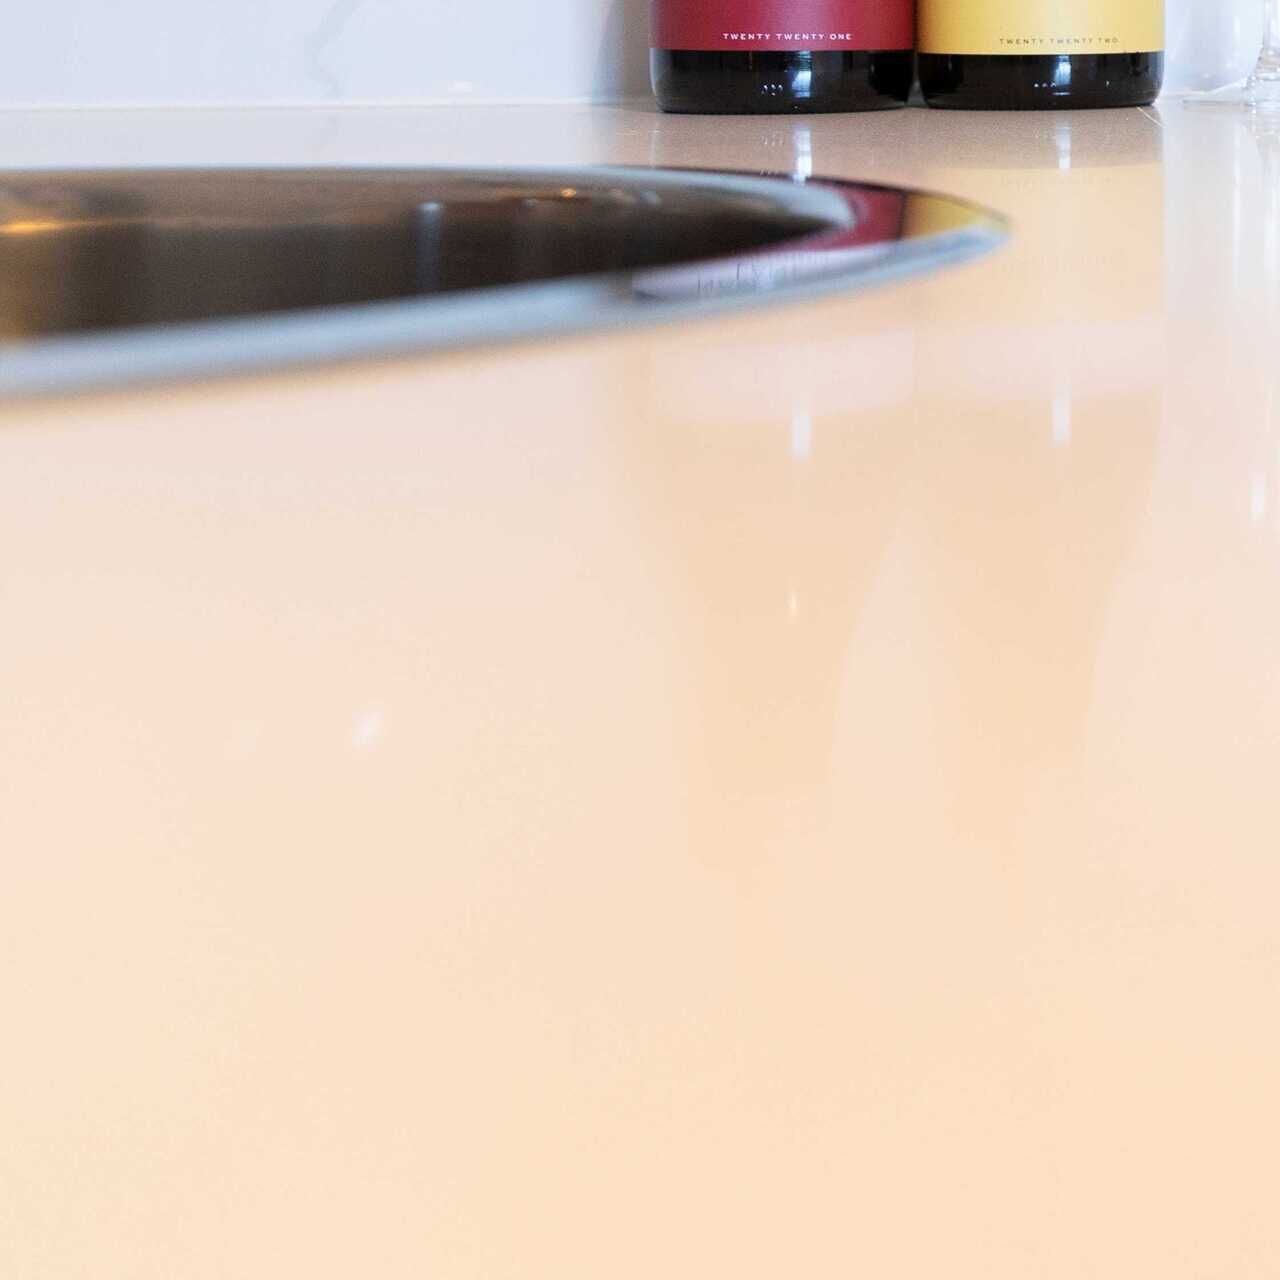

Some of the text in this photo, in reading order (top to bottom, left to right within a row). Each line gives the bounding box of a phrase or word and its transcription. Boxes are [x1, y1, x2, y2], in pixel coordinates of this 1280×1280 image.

[722, 32, 853, 40] TWENTY TWENTY ONE
[1050, 37, 1093, 45] TWENTY
